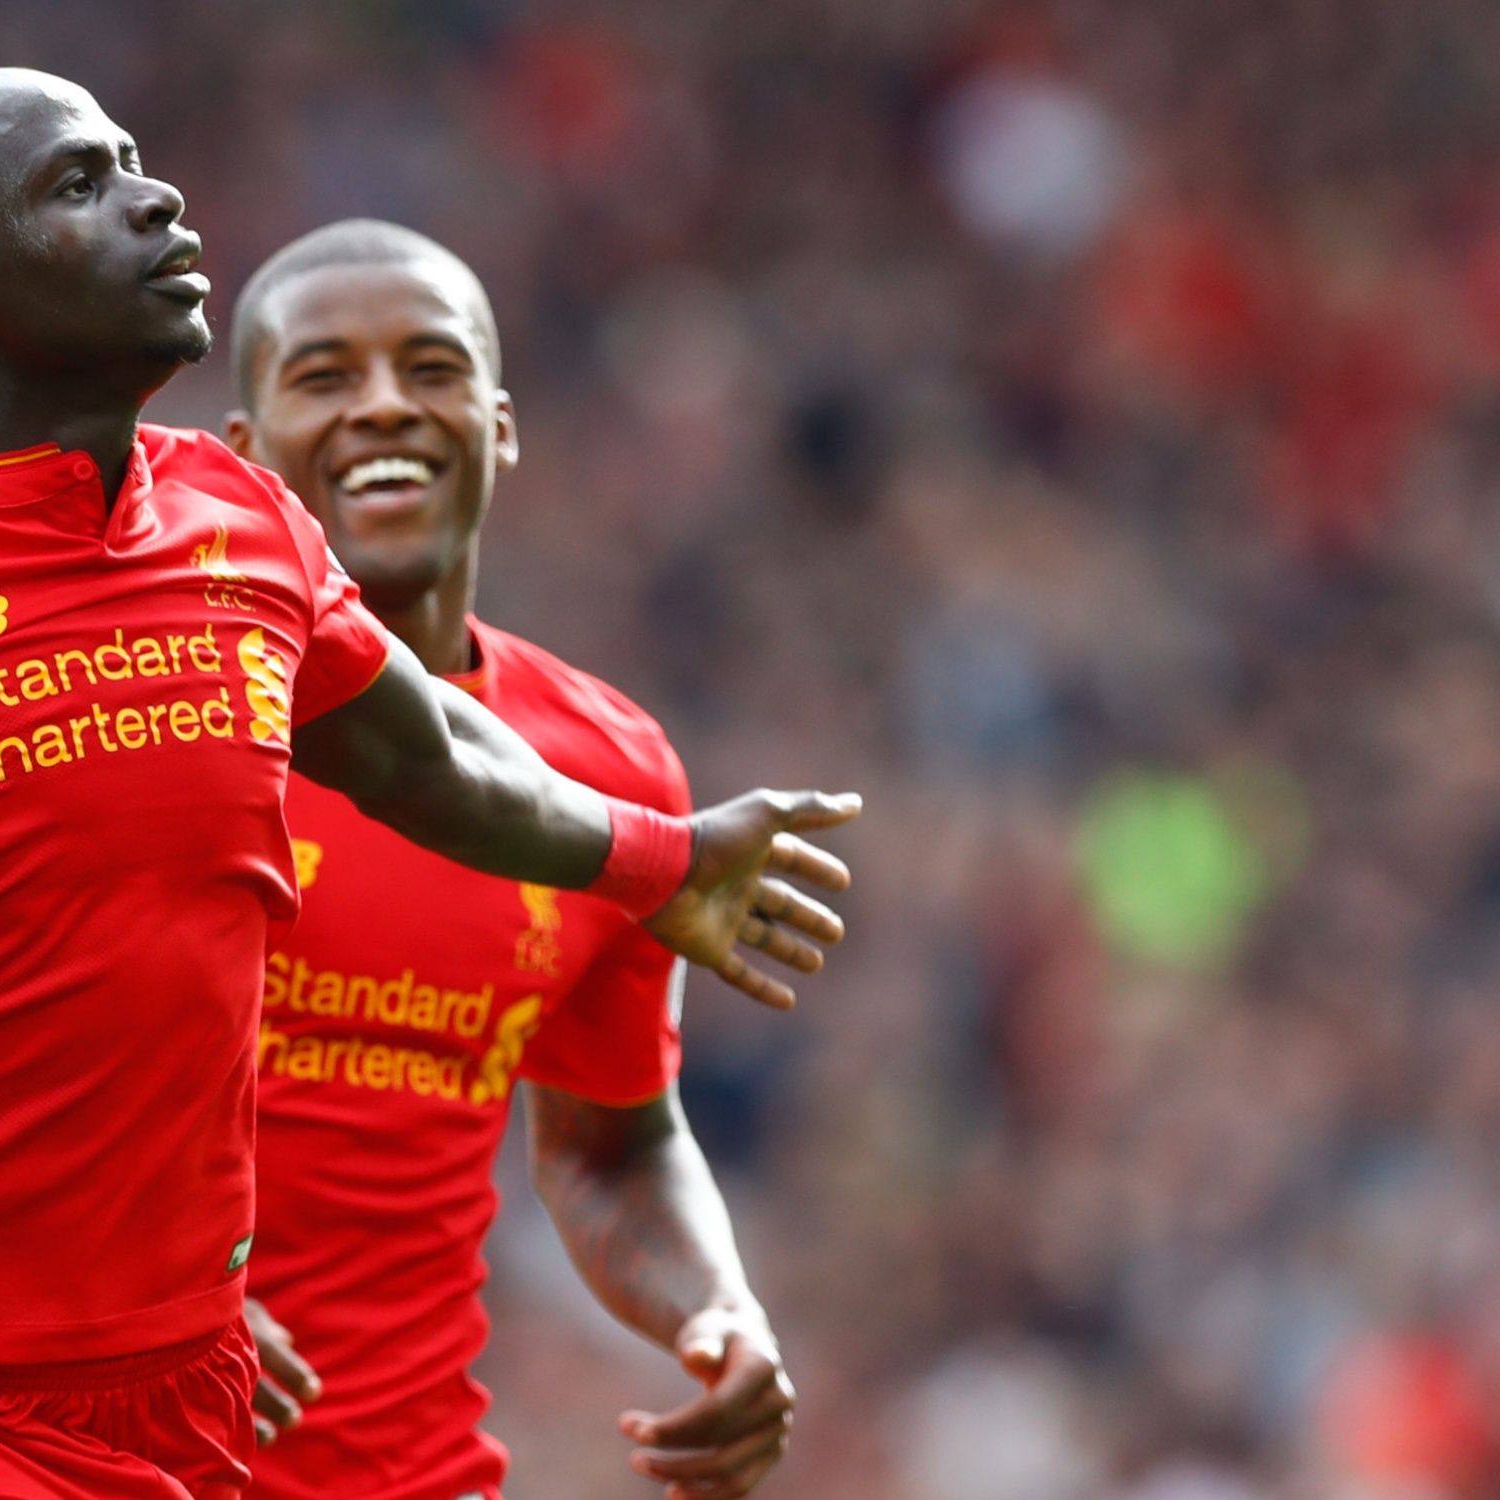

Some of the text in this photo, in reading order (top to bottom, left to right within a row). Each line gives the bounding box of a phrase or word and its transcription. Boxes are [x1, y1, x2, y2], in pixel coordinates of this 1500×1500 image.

[289, 837, 324, 890] B
[262, 951, 495, 1039] Standard
[257, 1018, 468, 1101] hartered
